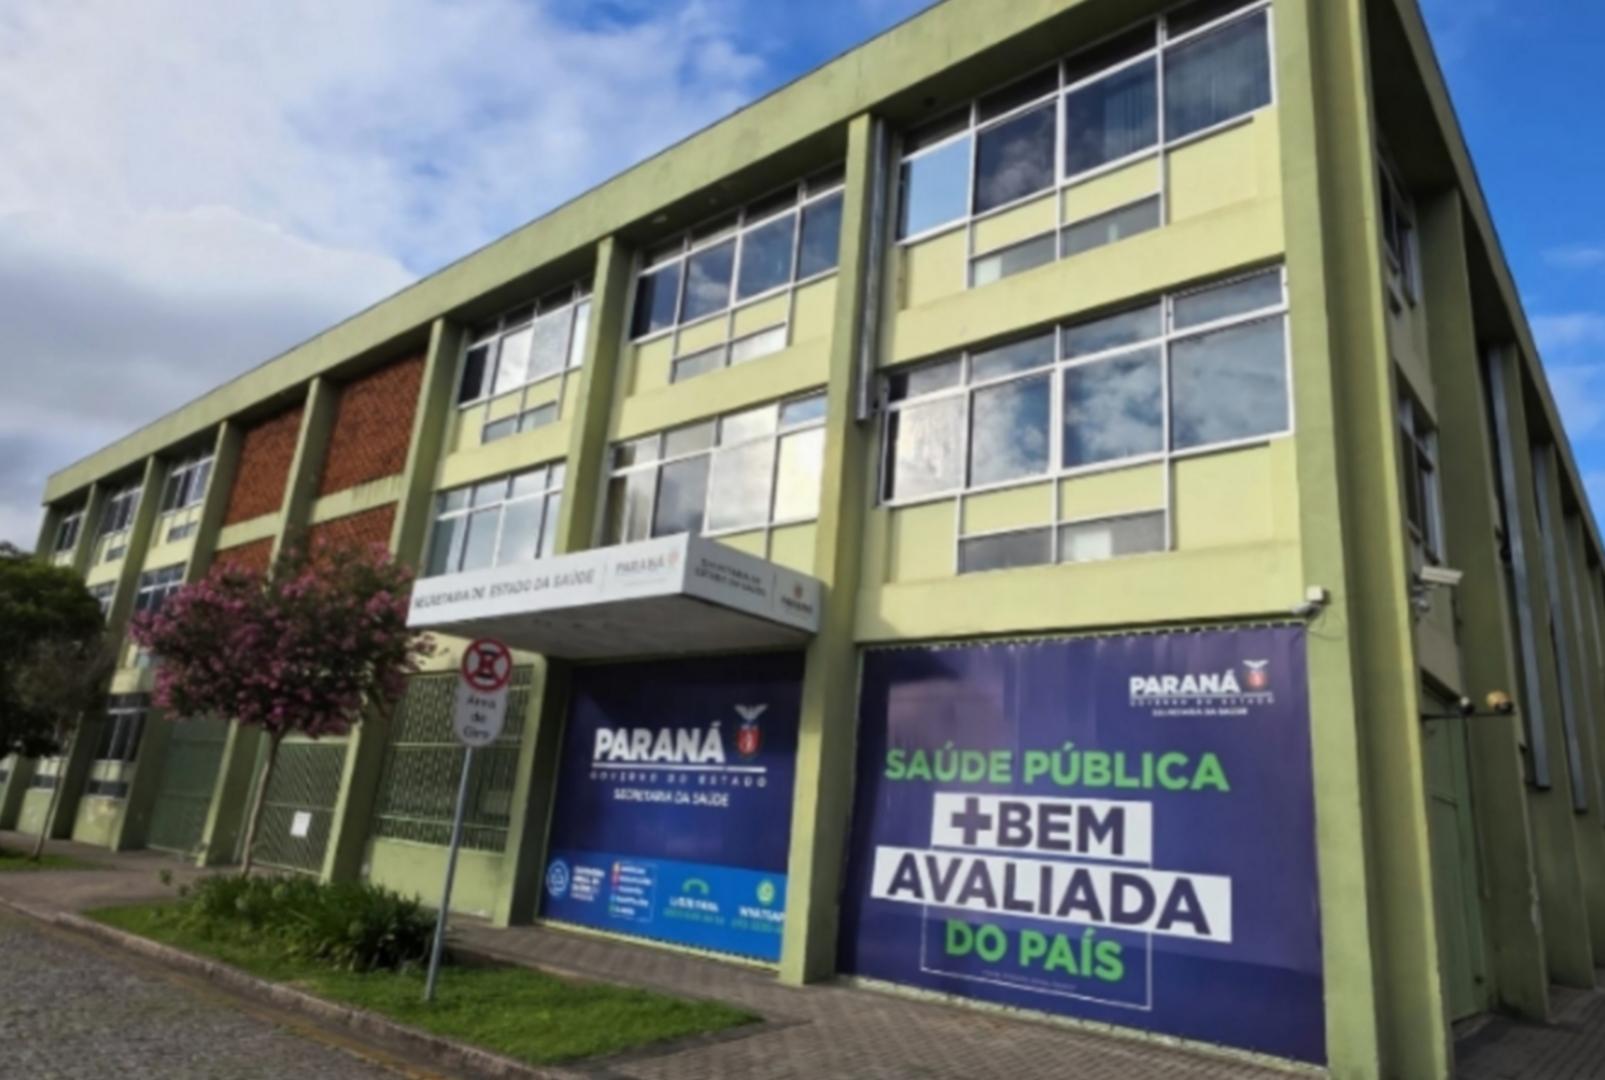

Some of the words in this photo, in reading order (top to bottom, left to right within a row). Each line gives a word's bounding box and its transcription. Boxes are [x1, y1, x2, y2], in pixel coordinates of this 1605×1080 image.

[489, 579, 531, 598] ESTADO
[533, 576, 549, 591] DA
[552, 568, 595, 588] SAÚDE
[1129, 669, 1241, 694] PARANÁ
[593, 721, 725, 763] PARANÁ
[885, 742, 1012, 782] SAÚDE
[1023, 742, 1230, 791] PÚBLICA
[886, 853, 1212, 936] AVALIADA
[944, 919, 1008, 961] DO
[1019, 928, 1125, 981] PAÍS
